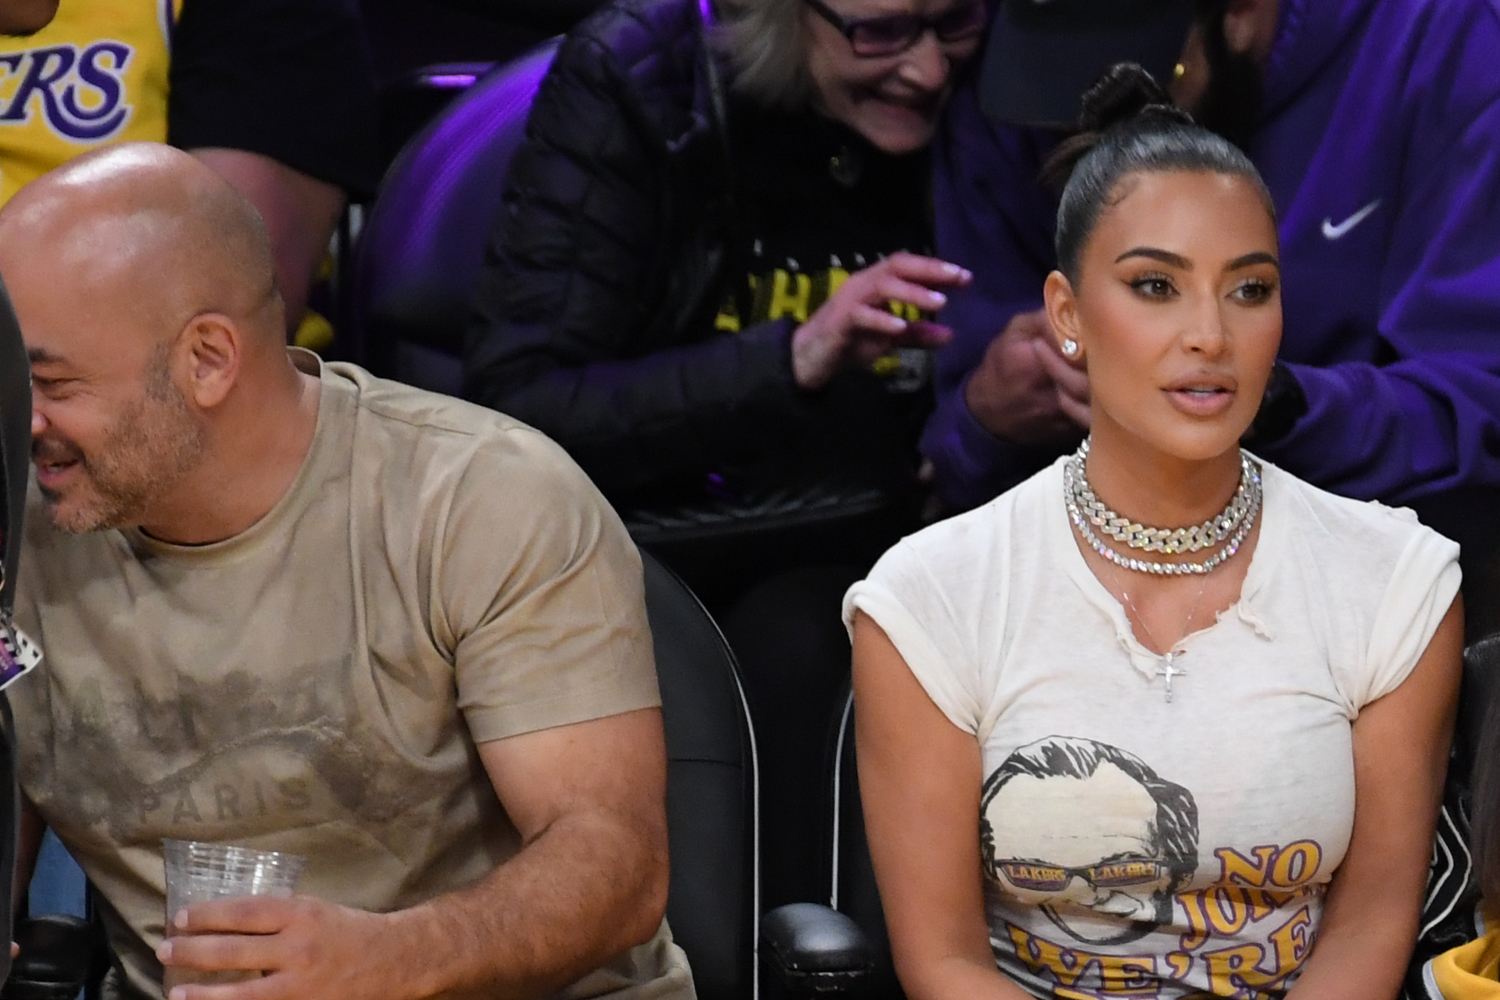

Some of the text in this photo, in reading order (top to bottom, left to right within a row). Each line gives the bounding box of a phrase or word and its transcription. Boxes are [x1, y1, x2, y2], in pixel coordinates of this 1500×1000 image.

[136, 777, 313, 824] PARIS
[1007, 864, 1066, 881] LAKERS
[1213, 839, 1322, 887] NO
